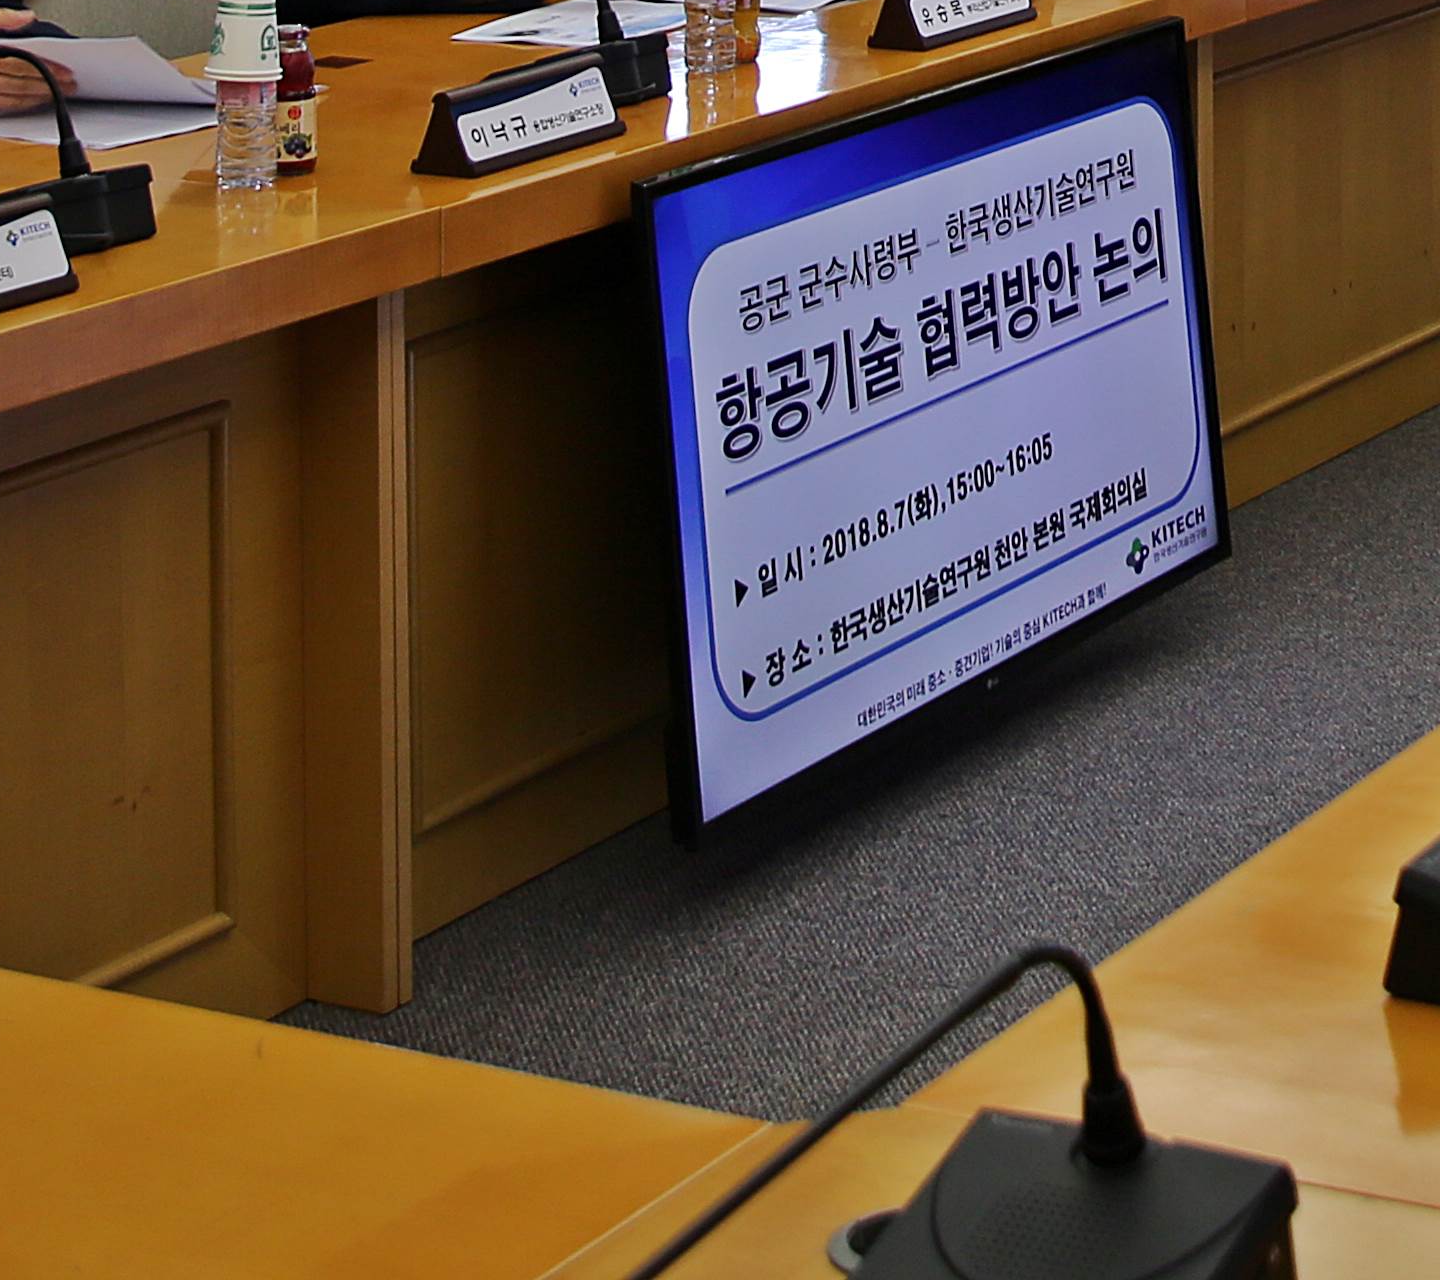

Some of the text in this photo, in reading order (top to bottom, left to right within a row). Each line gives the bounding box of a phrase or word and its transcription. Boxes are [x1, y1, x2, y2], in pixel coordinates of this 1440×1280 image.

[20, 221, 51, 238] KITECH
[739, 285, 791, 333] 공군
[798, 231, 922, 310] 군수사령부
[945, 149, 1136, 252] 한국생산기술연구원
[715, 207, 1169, 461] 항공기술 협력방안 논의
[830, 545, 991, 654] 한국생산기술연구원
[995, 530, 1028, 574] 천안
[1033, 507, 1066, 553] 본원
[1070, 468, 1149, 538] 국제회의실
[1151, 506, 1205, 547] KITECH
[858, 691, 905, 727] 대한민국의
[907, 682, 926, 700] 미래
[928, 671, 946, 690] 중소
[996, 631, 1021, 654] 기술의
[1023, 622, 1041, 639] 중심
[1043, 596, 1085, 629] KITECH과
[1086, 582, 1107, 608] 함께!
